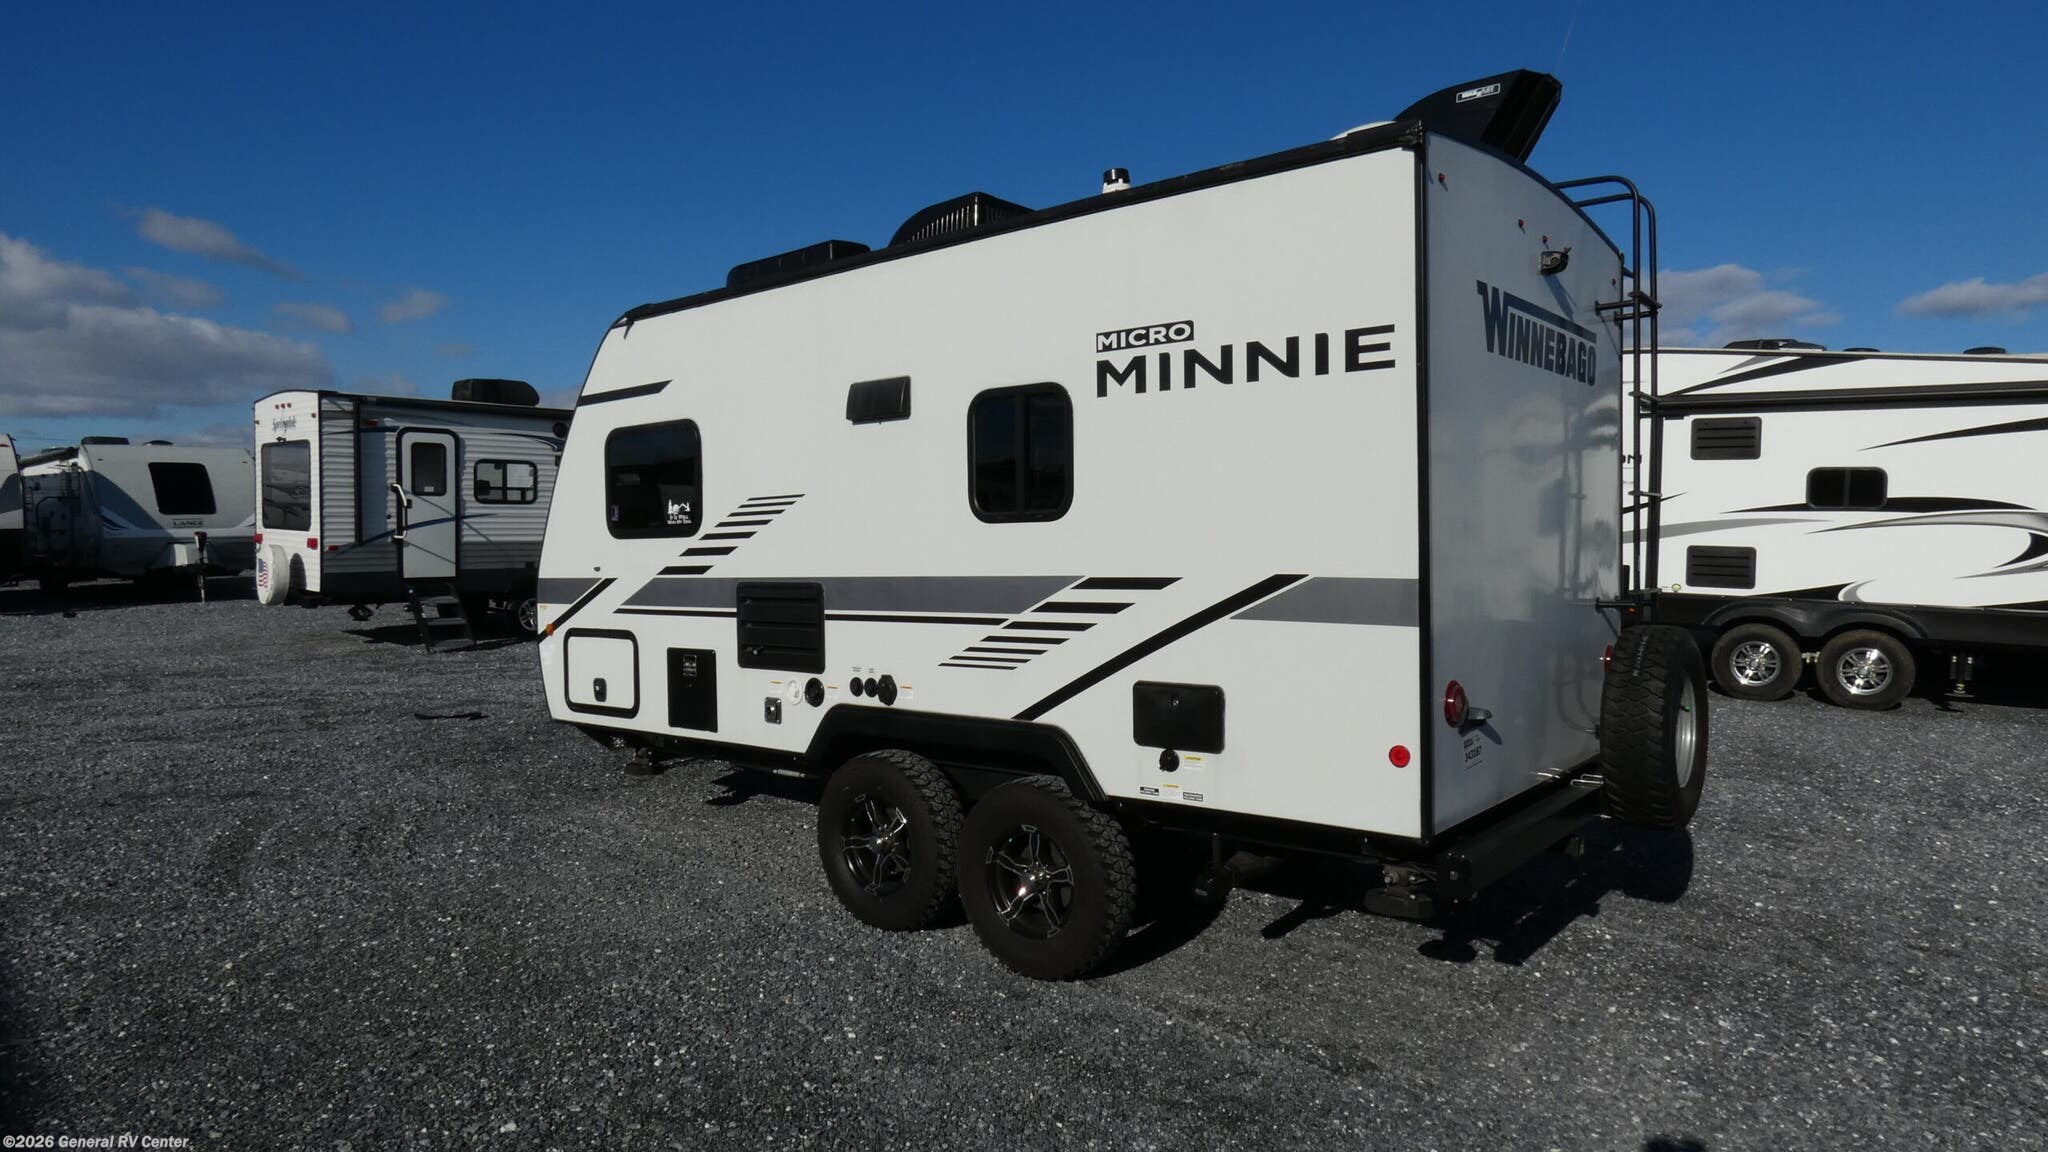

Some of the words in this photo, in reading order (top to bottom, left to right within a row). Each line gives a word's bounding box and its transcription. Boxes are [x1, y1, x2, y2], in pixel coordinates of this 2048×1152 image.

[1096, 324, 1396, 398] MINNIE
[1097, 321, 1192, 351] MICRO
[1476, 280, 1597, 386] WINNEBAGO
